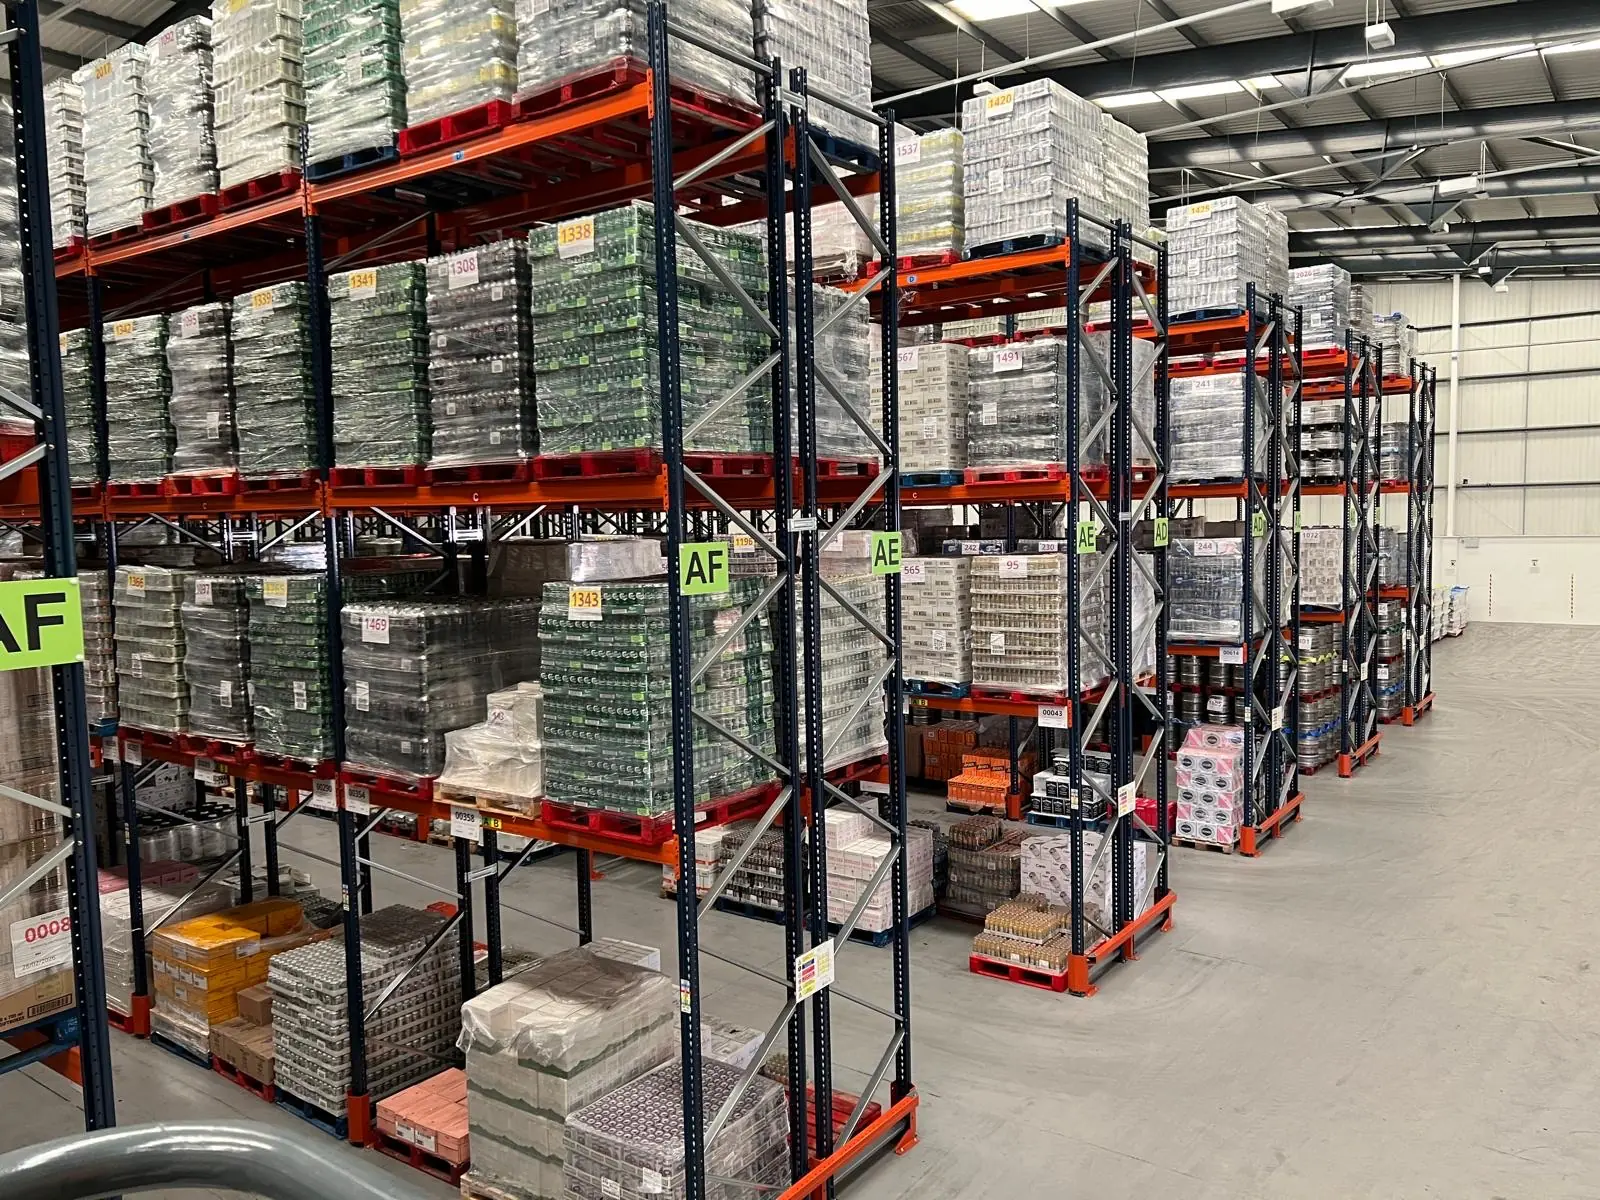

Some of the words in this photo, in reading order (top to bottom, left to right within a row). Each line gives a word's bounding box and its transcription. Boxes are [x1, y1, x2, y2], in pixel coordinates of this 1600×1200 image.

[987, 94, 1012, 108] 1420
[896, 143, 918, 157] 1537
[561, 224, 592, 243] 1338
[451, 257, 476, 275] 1308
[351, 276, 373, 288] 1341
[996, 351, 1019, 363] 1491
[1079, 524, 1094, 548] AE
[1156, 522, 1167, 542] AD
[735, 537, 753, 546] 1196
[874, 538, 899, 567] AE
[685, 550, 723, 585] AF
[904, 565, 920, 575] 565
[1006, 560, 1019, 570] 95
[571, 592, 599, 607] 1343
[365, 618, 387, 631] 1469
[1042, 709, 1063, 717] 00043
[455, 811, 475, 823] 00358
